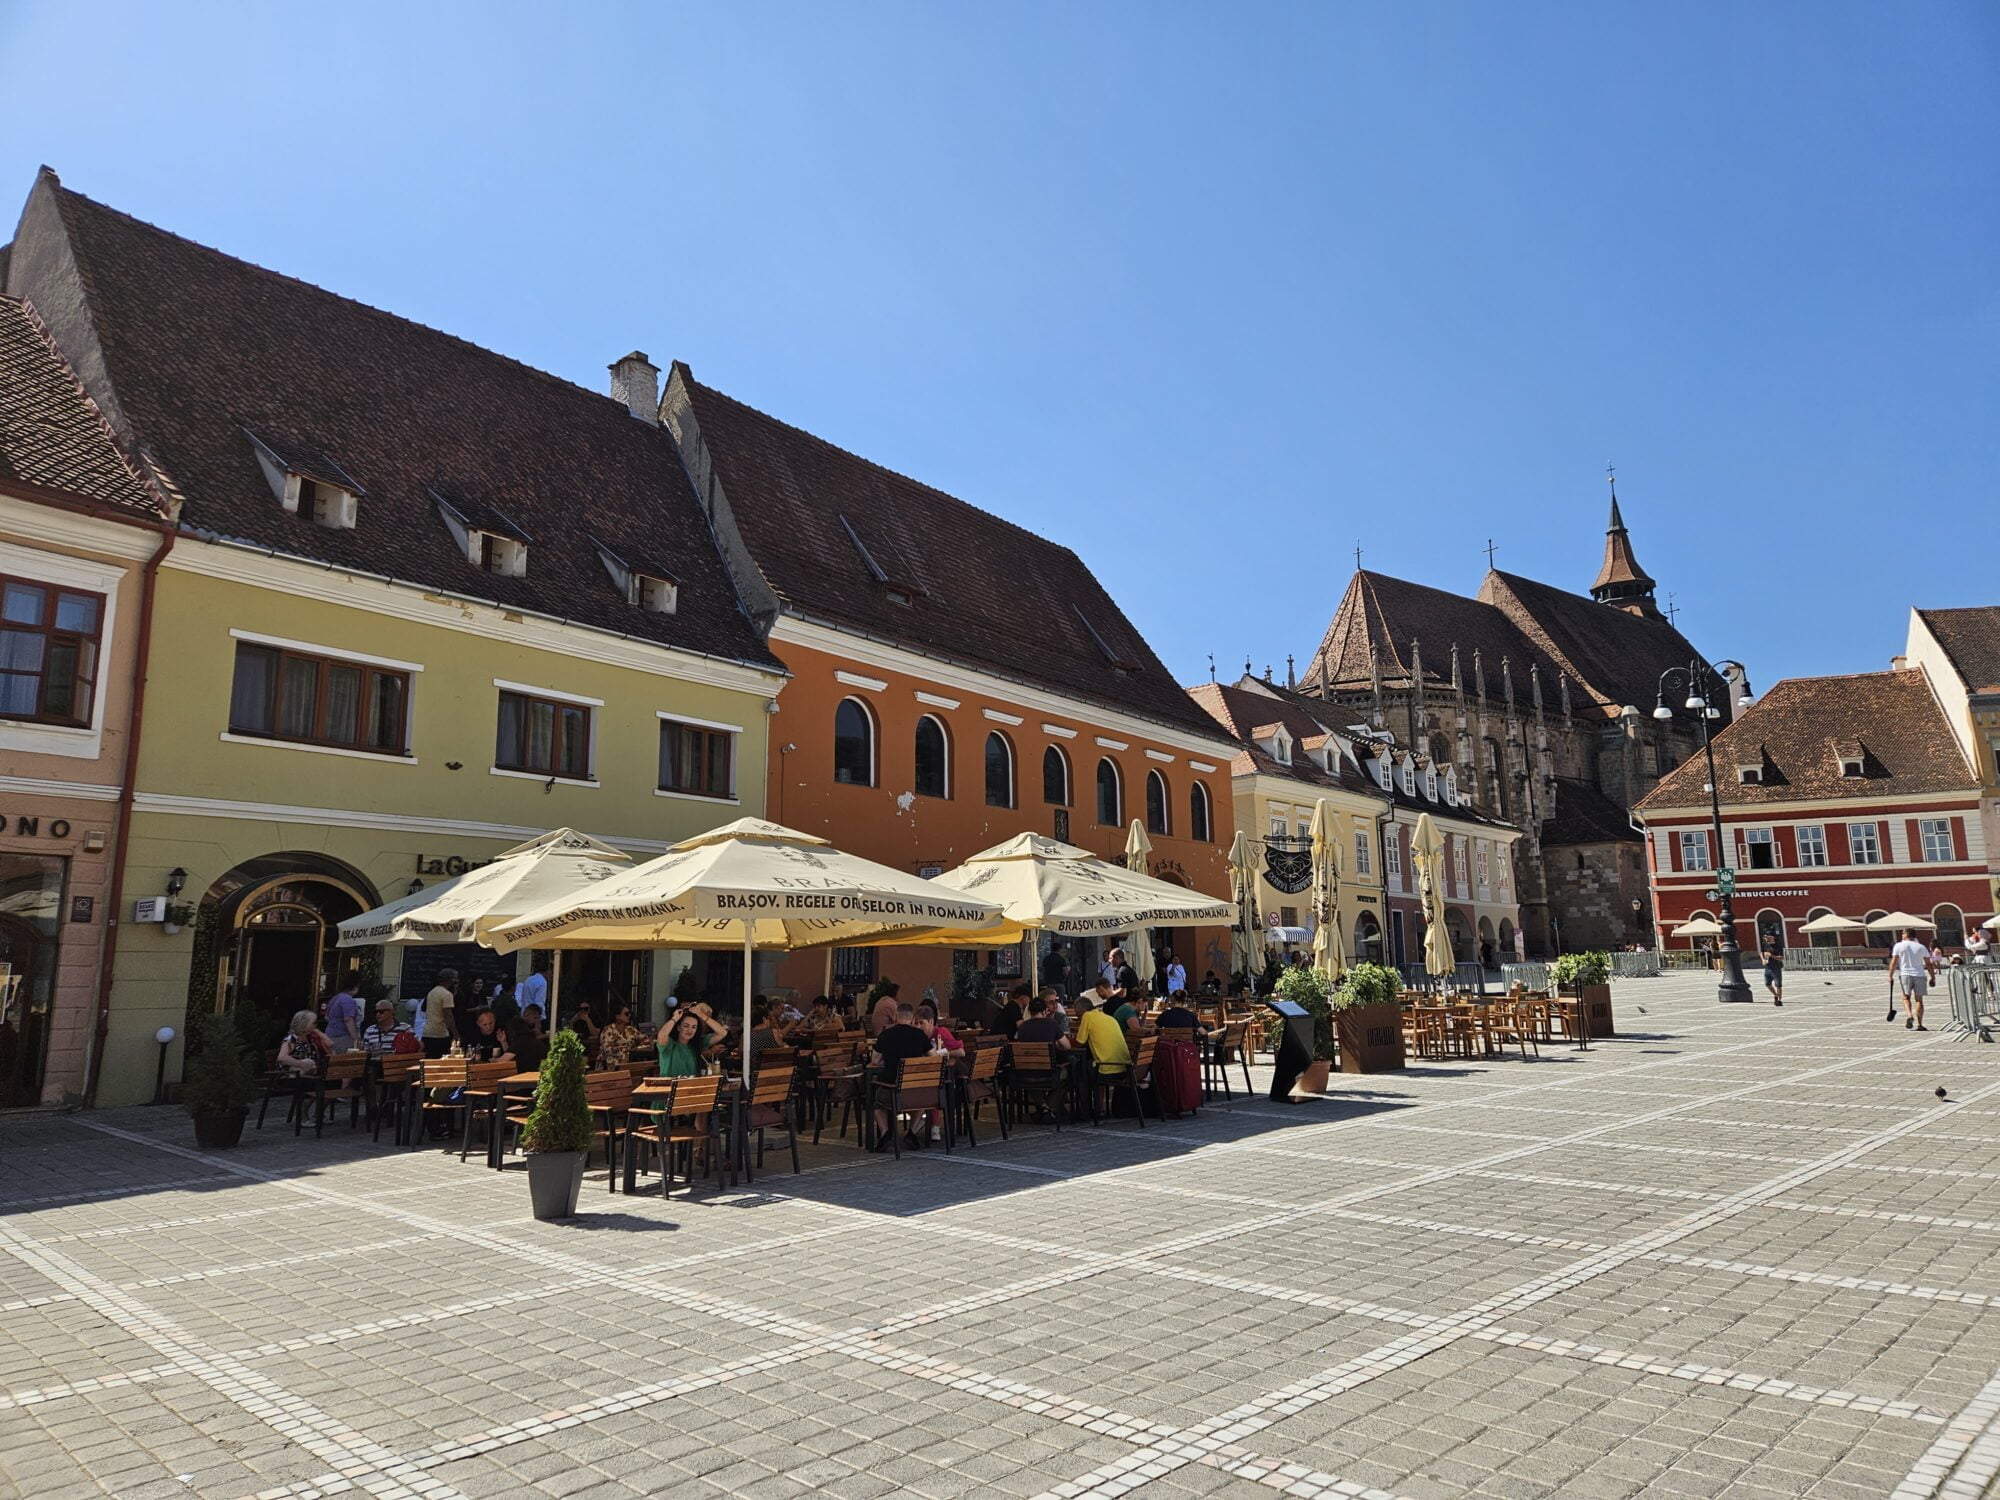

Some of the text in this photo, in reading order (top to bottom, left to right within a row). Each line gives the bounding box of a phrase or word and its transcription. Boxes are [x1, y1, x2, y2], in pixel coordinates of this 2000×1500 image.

[1729, 889, 1809, 898] TARBUCKS COFFEE
[786, 895, 836, 909] REGELE
[909, 901, 924, 916] ÎN
[369, 923, 393, 937] REGELE
[538, 913, 568, 932] REGELE
[1100, 915, 1133, 931] REGELE
